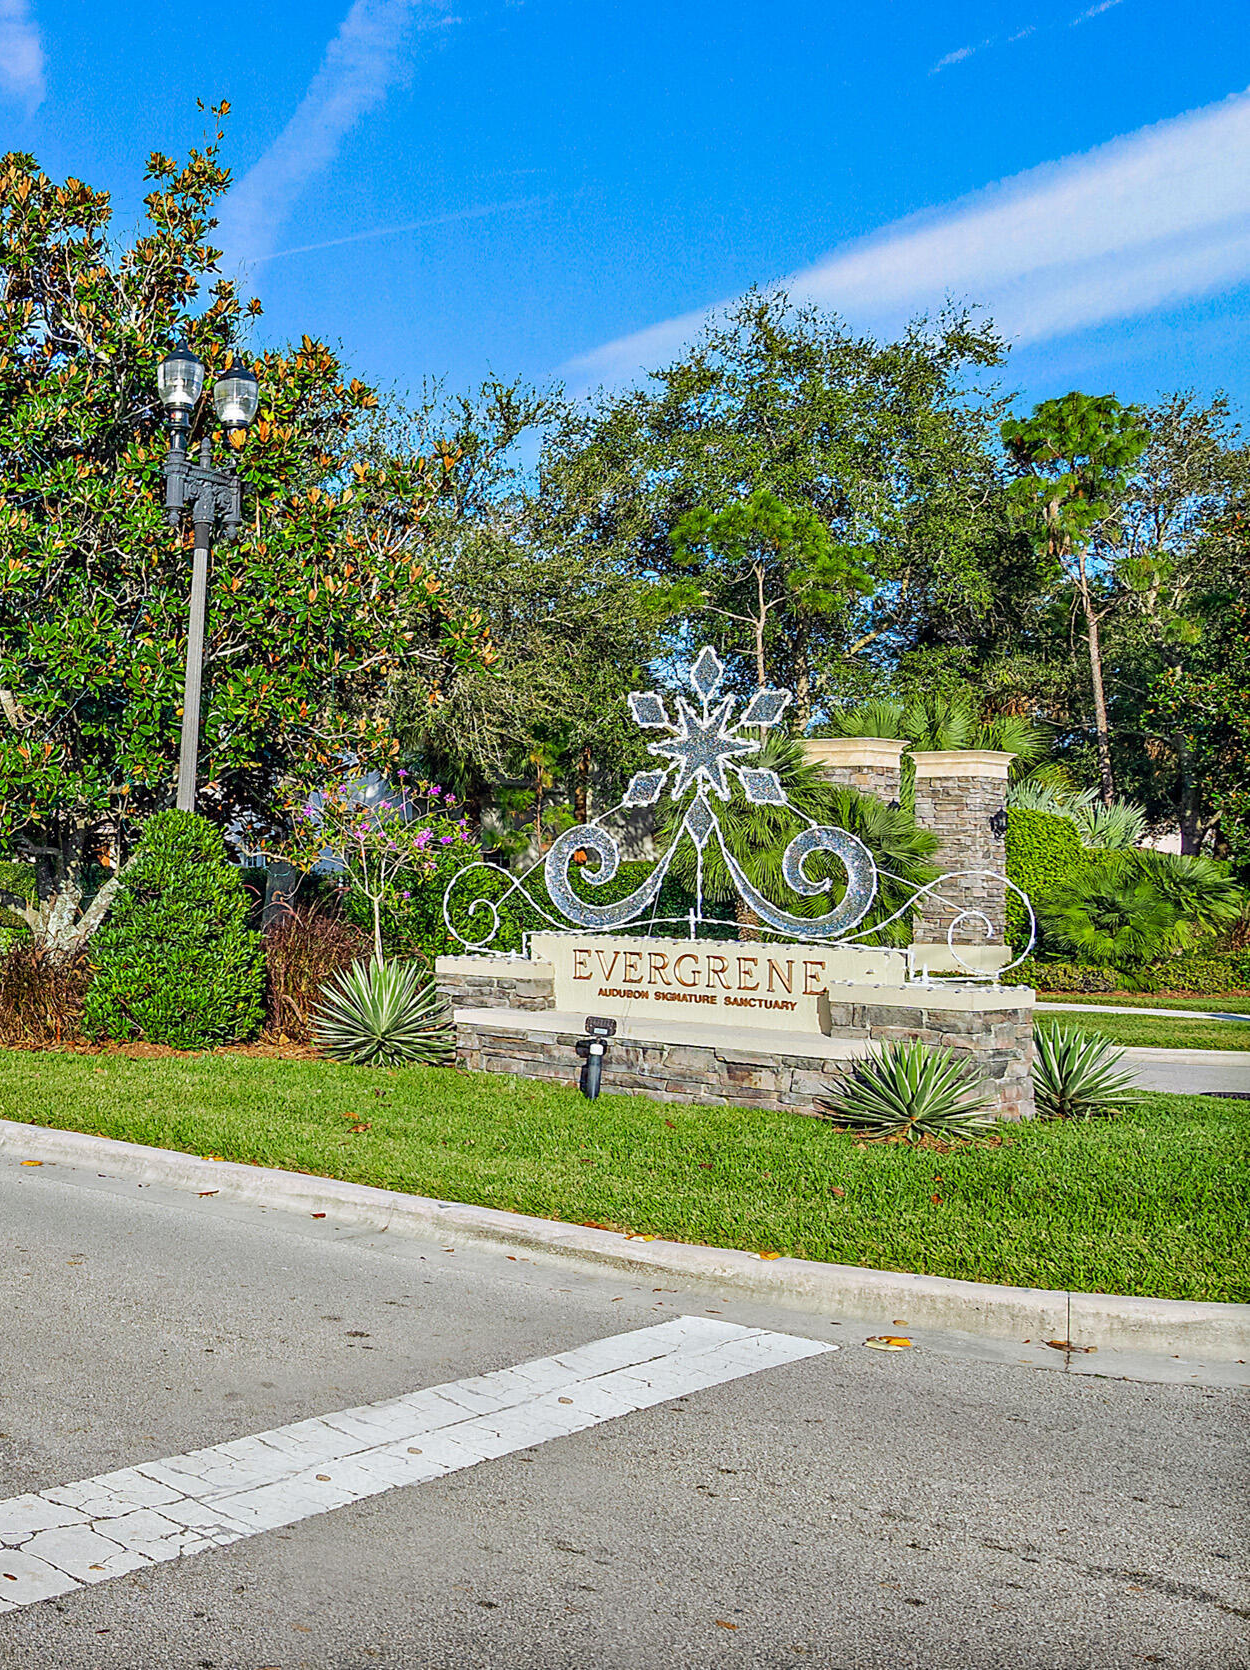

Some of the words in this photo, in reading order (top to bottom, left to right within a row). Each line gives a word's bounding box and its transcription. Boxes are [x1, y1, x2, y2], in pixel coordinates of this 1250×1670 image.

[573, 949, 828, 995] EVERGRENE
[598, 987, 649, 1000] AUDUBON
[654, 991, 718, 1005] SIGNATURE
[723, 996, 798, 1011] SANCTUARY
